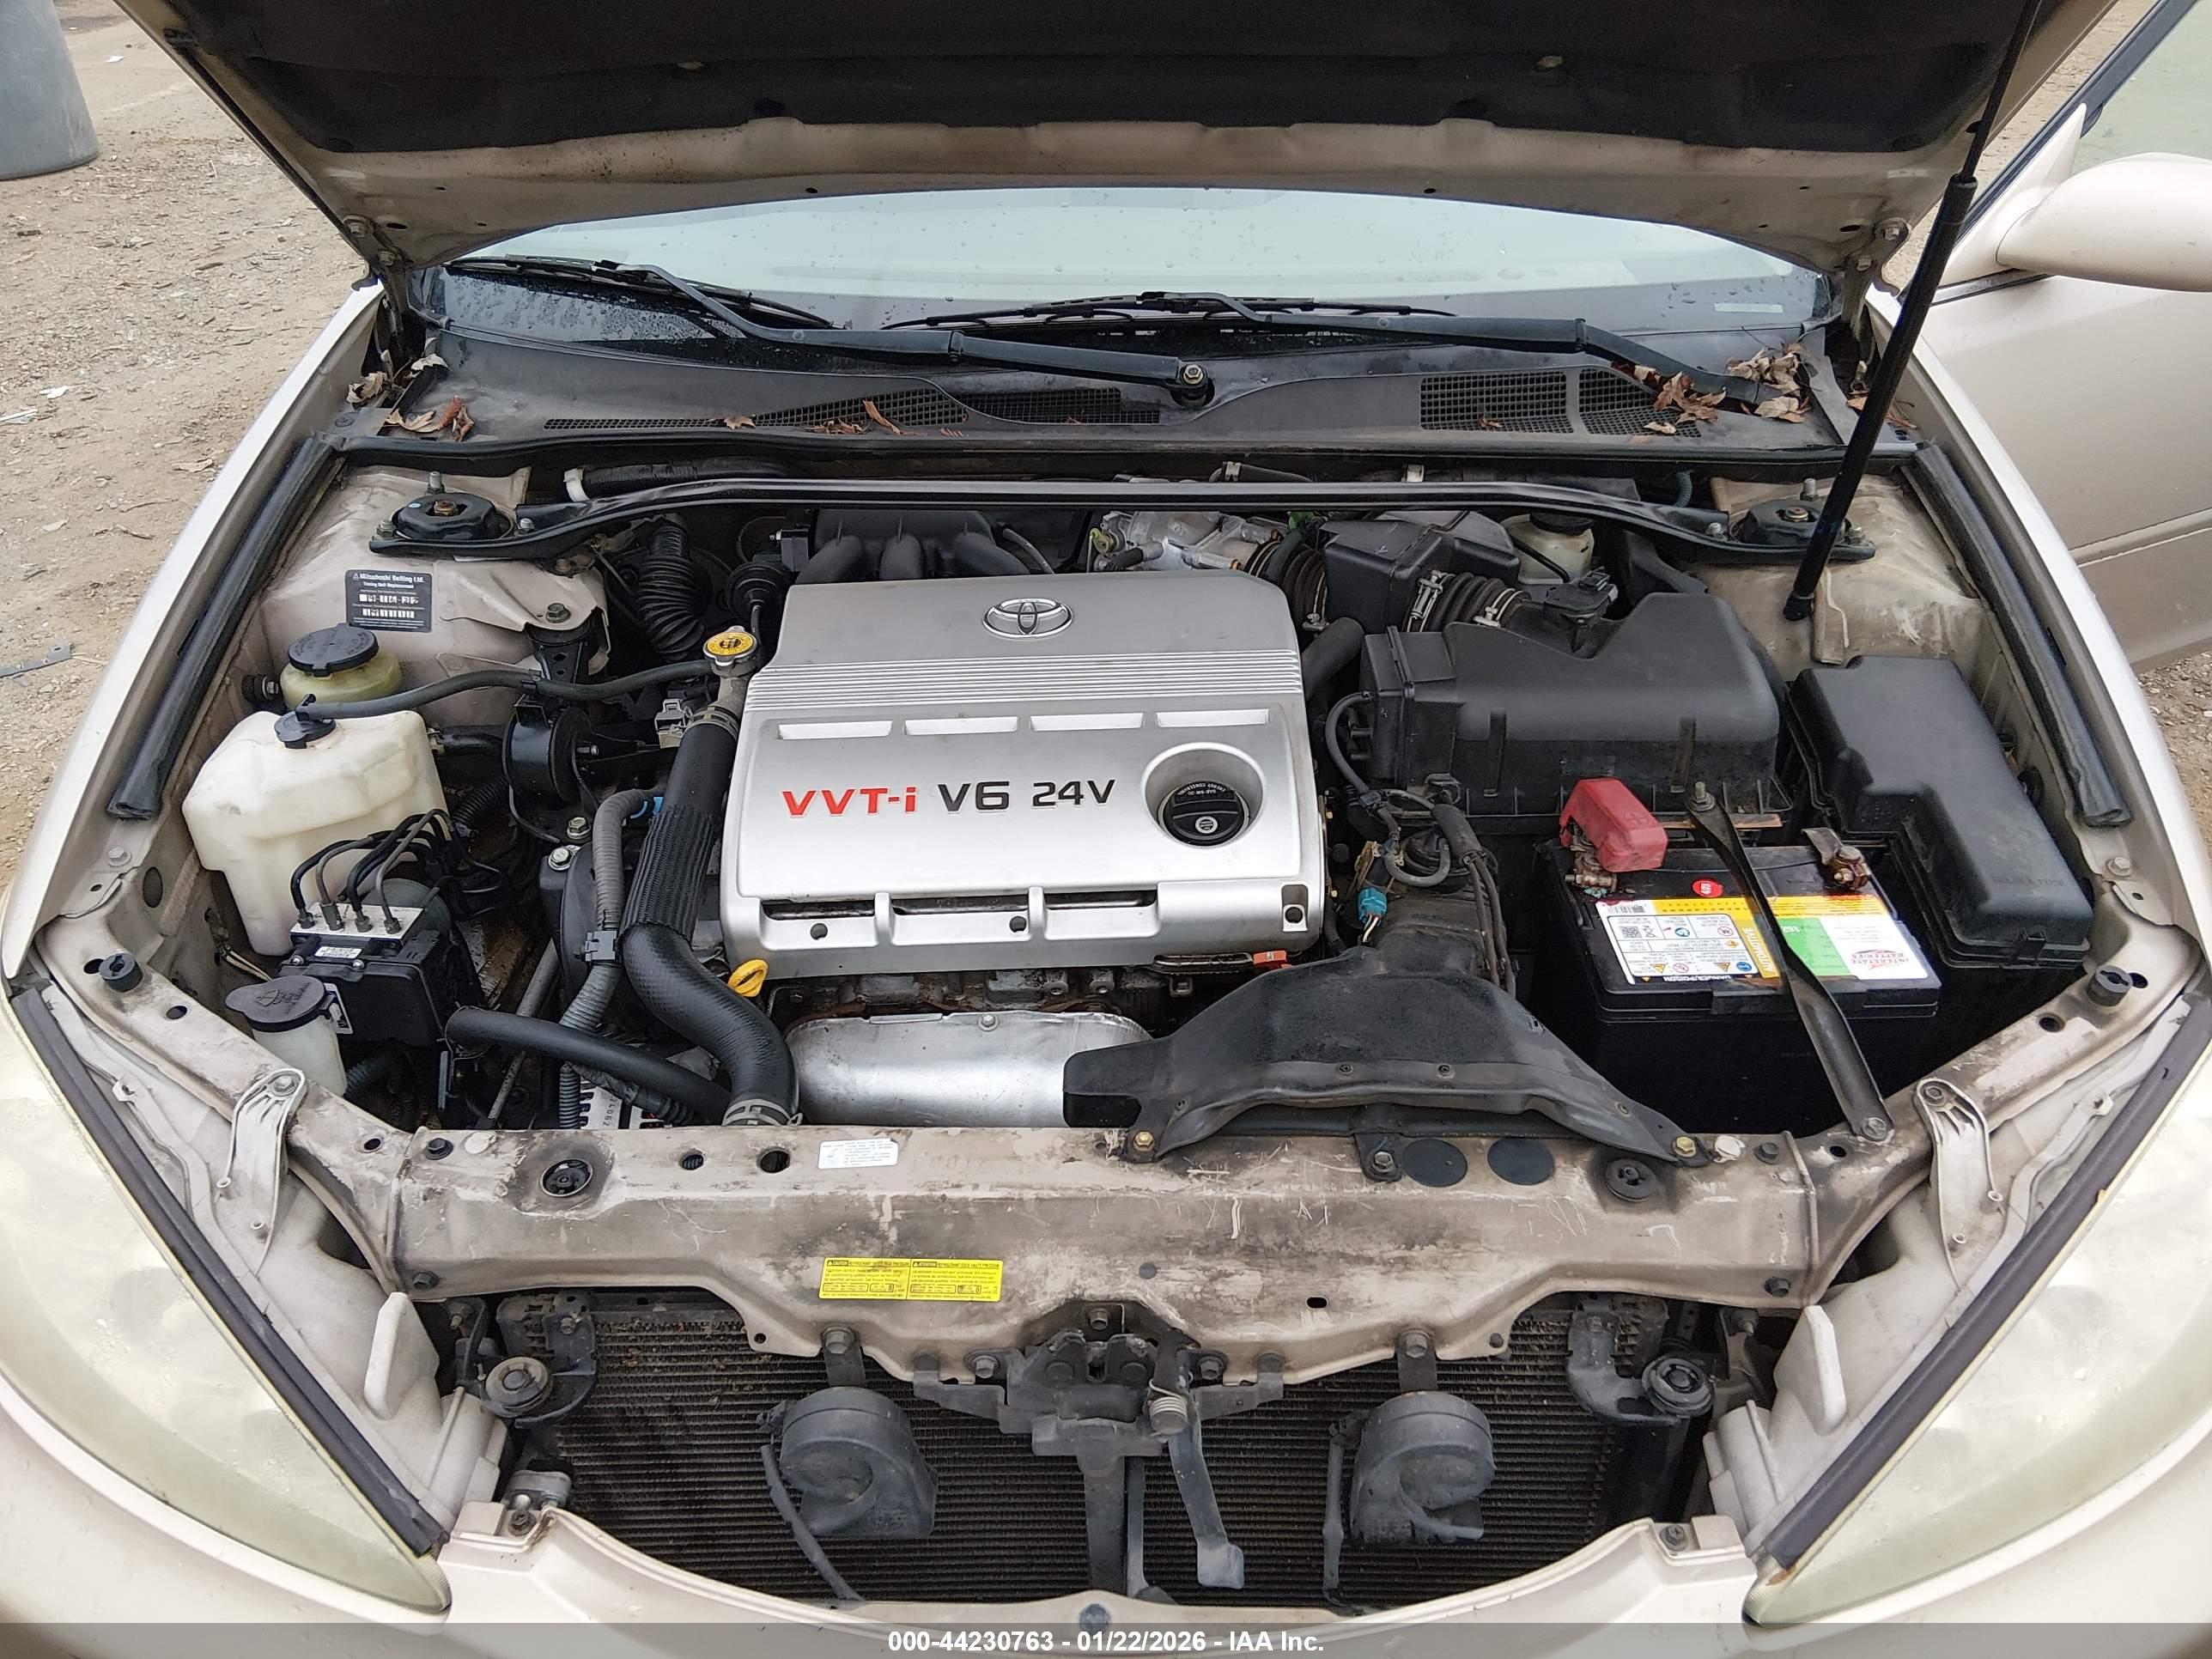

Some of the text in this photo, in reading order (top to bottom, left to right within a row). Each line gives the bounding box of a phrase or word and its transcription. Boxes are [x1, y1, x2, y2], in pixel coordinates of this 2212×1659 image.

[781, 778, 1116, 817] VVT-i V6 24V
[1741, 927, 1775, 973] AUTOMOTIVE
